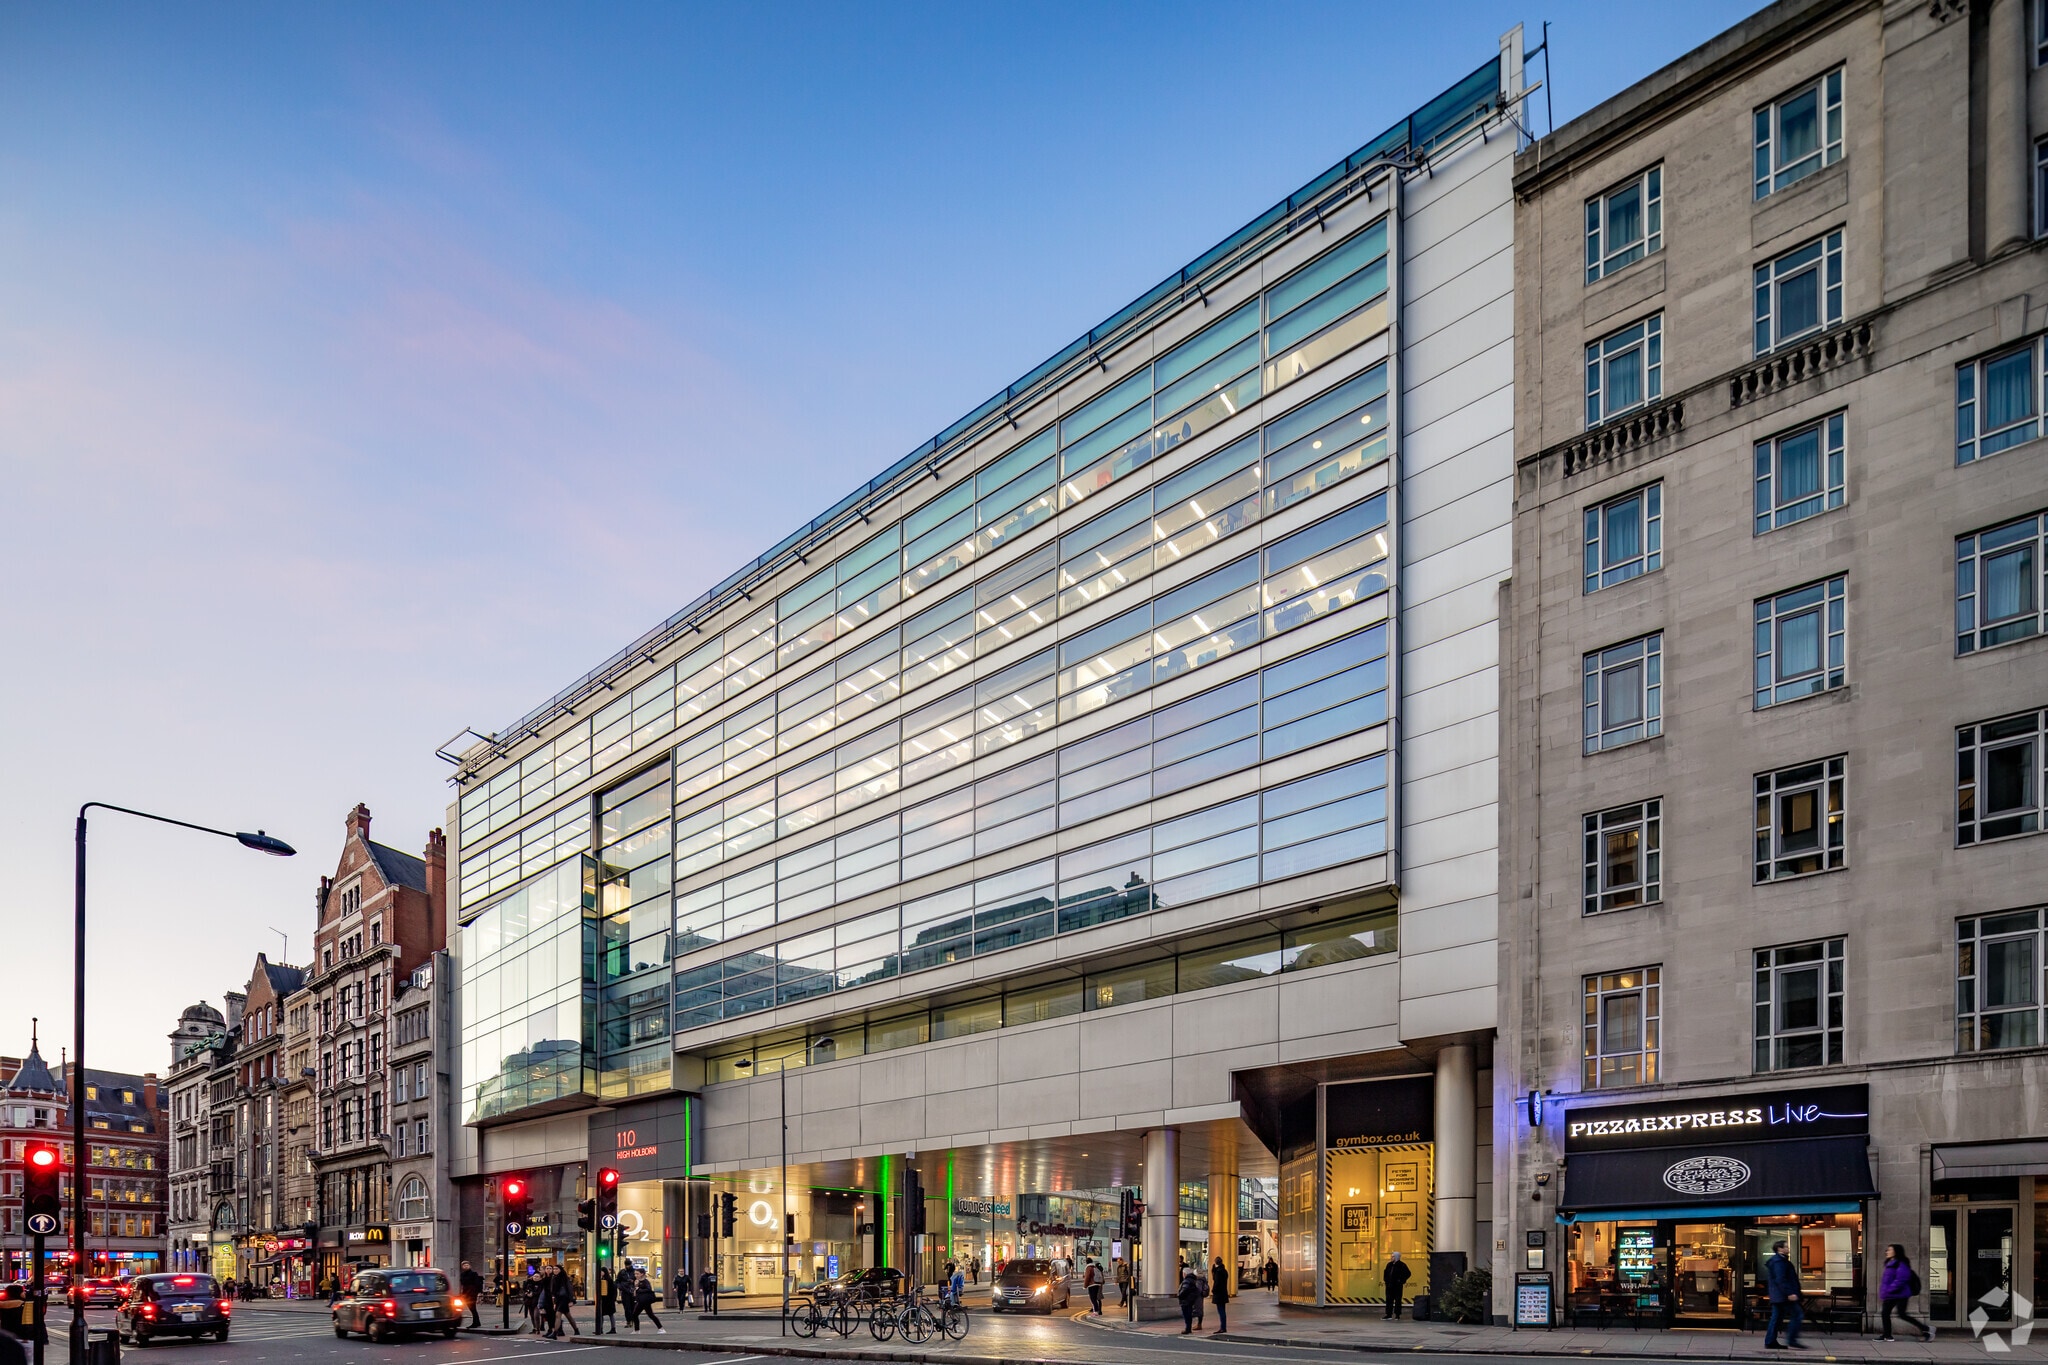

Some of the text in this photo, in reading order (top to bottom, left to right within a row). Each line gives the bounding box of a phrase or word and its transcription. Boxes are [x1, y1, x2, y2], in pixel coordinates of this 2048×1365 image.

[1570, 1108, 1763, 1137] PIZZAEXPRESS
[1769, 1103, 1842, 1125] Live
[617, 1130, 636, 1148] 110
[1336, 1131, 1420, 1147] gymbox.co.uk
[616, 1146, 657, 1160] HIGH HOLBORN
[1347, 1209, 1366, 1218] GYM
[1347, 1218, 1366, 1227] BOX
